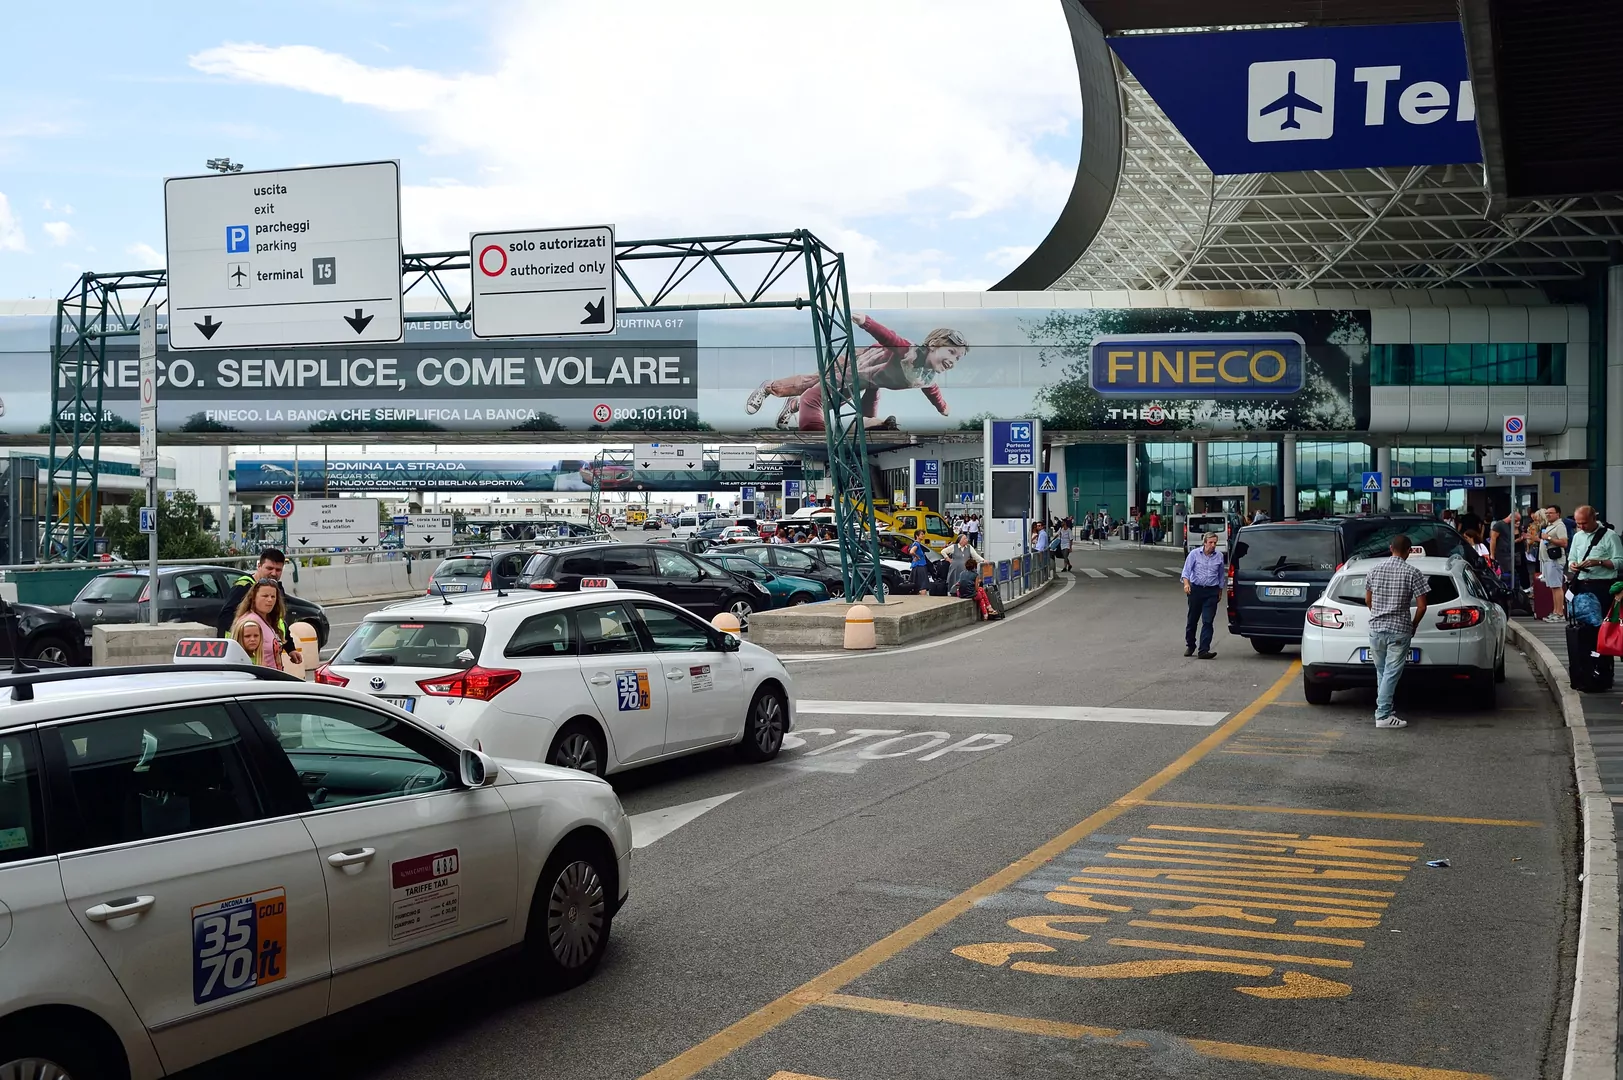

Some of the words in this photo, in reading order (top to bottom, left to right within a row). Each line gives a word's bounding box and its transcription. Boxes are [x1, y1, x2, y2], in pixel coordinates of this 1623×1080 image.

[253, 184, 287, 196] uscita
[254, 204, 275, 215] exit
[255, 220, 310, 235] parcheggi
[231, 228, 246, 250] P
[509, 240, 535, 252] solo
[539, 236, 606, 250] autorizzati
[256, 240, 297, 254] parking
[257, 268, 304, 281] terminal
[317, 264, 332, 279] T5
[510, 262, 575, 276] authorized
[579, 261, 606, 275] only
[404, 321, 430, 330] IALE
[434, 321, 452, 330] DEI
[664, 319, 684, 328] 617
[217, 358, 406, 391] SEMPLICE,
[416, 357, 525, 387] COME
[535, 356, 690, 385] VOLARE.
[1108, 351, 1287, 383] FINECO
[205, 410, 262, 421] FINECO.
[266, 410, 284, 421] LA
[288, 409, 337, 421] BANCA
[340, 409, 371, 421] CHE
[375, 408, 460, 421] SEMPLIFICA
[464, 409, 483, 420] LA
[486, 408, 540, 420] BANCA.
[614, 408, 688, 420] 800.101.101
[1108, 409, 1151, 419] THE
[1161, 408, 1213, 419] NEW
[1222, 409, 1286, 420] BANK
[1011, 426, 1030, 439] T3
[385, 462, 405, 471] LA
[407, 462, 467, 471] STRADA
[926, 462, 937, 471] T3
[1550, 471, 1561, 493] 1
[1252, 487, 1260, 501] 2
[582, 579, 607, 588] TAXI
[180, 641, 225, 657] TAXI
[619, 675, 637, 693] 35
[781, 728, 1013, 762] STOP
[405, 882, 433, 897] TARIFFE
[433, 878, 449, 889] TAXI
[220, 898, 243, 909] ANCONA
[259, 901, 284, 919] GOLD
[200, 909, 253, 958] 35
